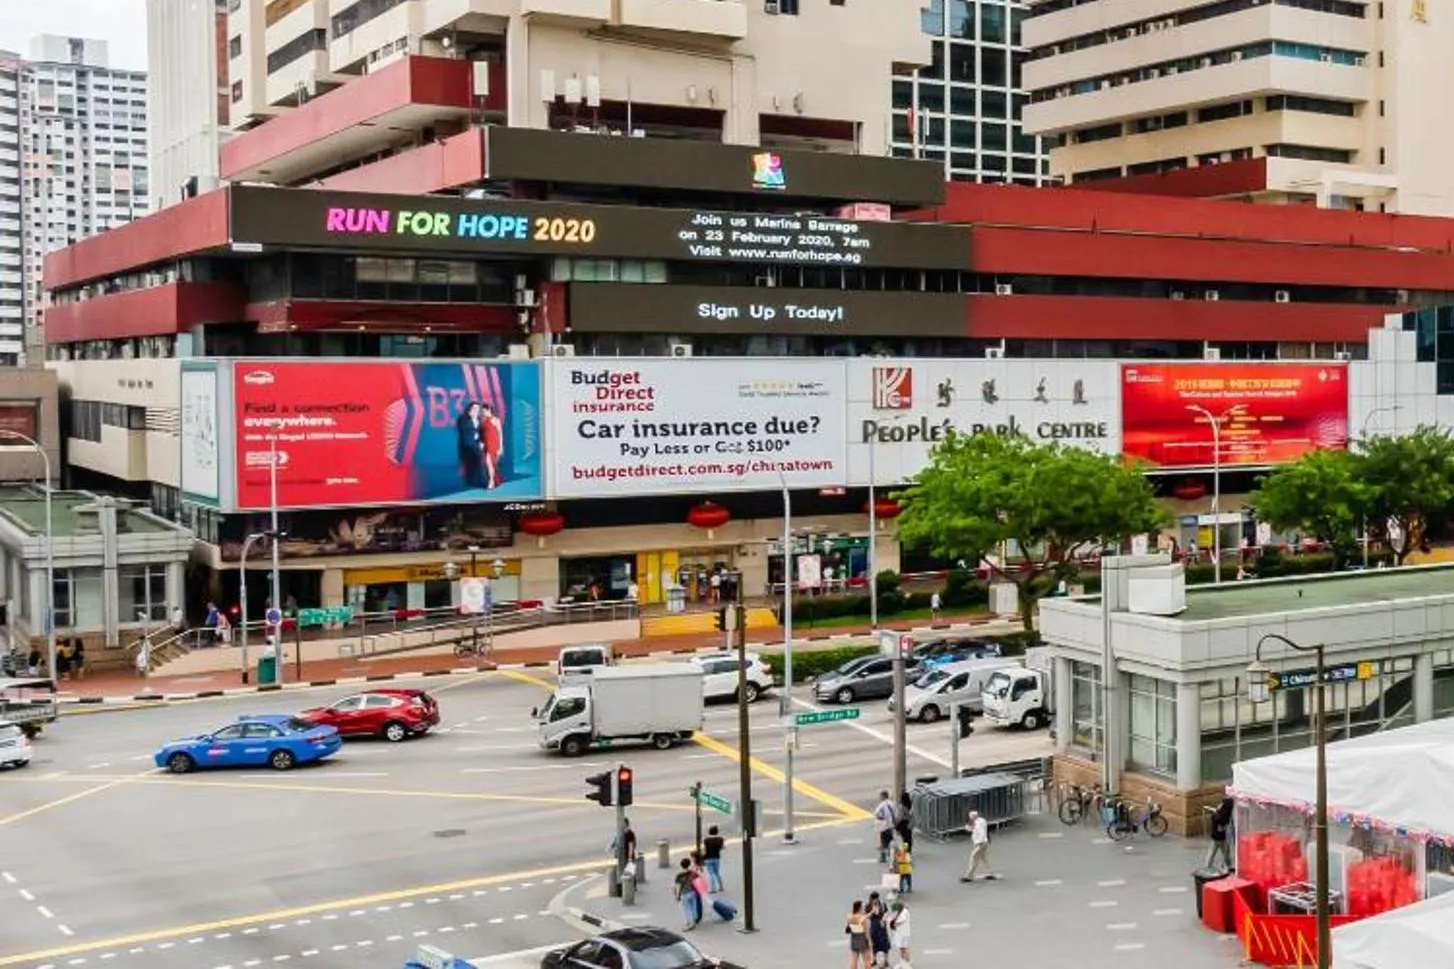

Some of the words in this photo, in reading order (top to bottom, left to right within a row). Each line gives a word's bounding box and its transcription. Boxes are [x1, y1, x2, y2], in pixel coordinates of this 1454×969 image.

[327, 208, 390, 233] RUN
[396, 212, 450, 235] FOR
[457, 215, 529, 239] HOPE
[533, 218, 595, 243] 2020
[691, 214, 722, 225] Join
[730, 217, 747, 226] us
[755, 217, 801, 230] Marina
[679, 231, 697, 240] on
[705, 230, 724, 241] 23
[732, 231, 791, 246] February
[798, 235, 835, 247] 2020,
[842, 237, 870, 248] 7am
[690, 245, 722, 257] Visit
[698, 303, 738, 320] Sign
[750, 304, 775, 320] Up
[785, 305, 843, 323] Today!
[571, 370, 642, 388] Budget
[596, 386, 655, 401] Direct
[244, 403, 277, 414] Find
[294, 401, 370, 414] connection
[572, 401, 655, 414] insurance
[243, 416, 337, 429] everywhere.
[577, 419, 624, 440] Car
[632, 417, 758, 438] insurance
[764, 414, 821, 435] due?
[1036, 421, 1108, 440] CENTRE
[620, 442, 650, 458] Pay
[654, 441, 690, 455] Less
[693, 444, 711, 454] or
